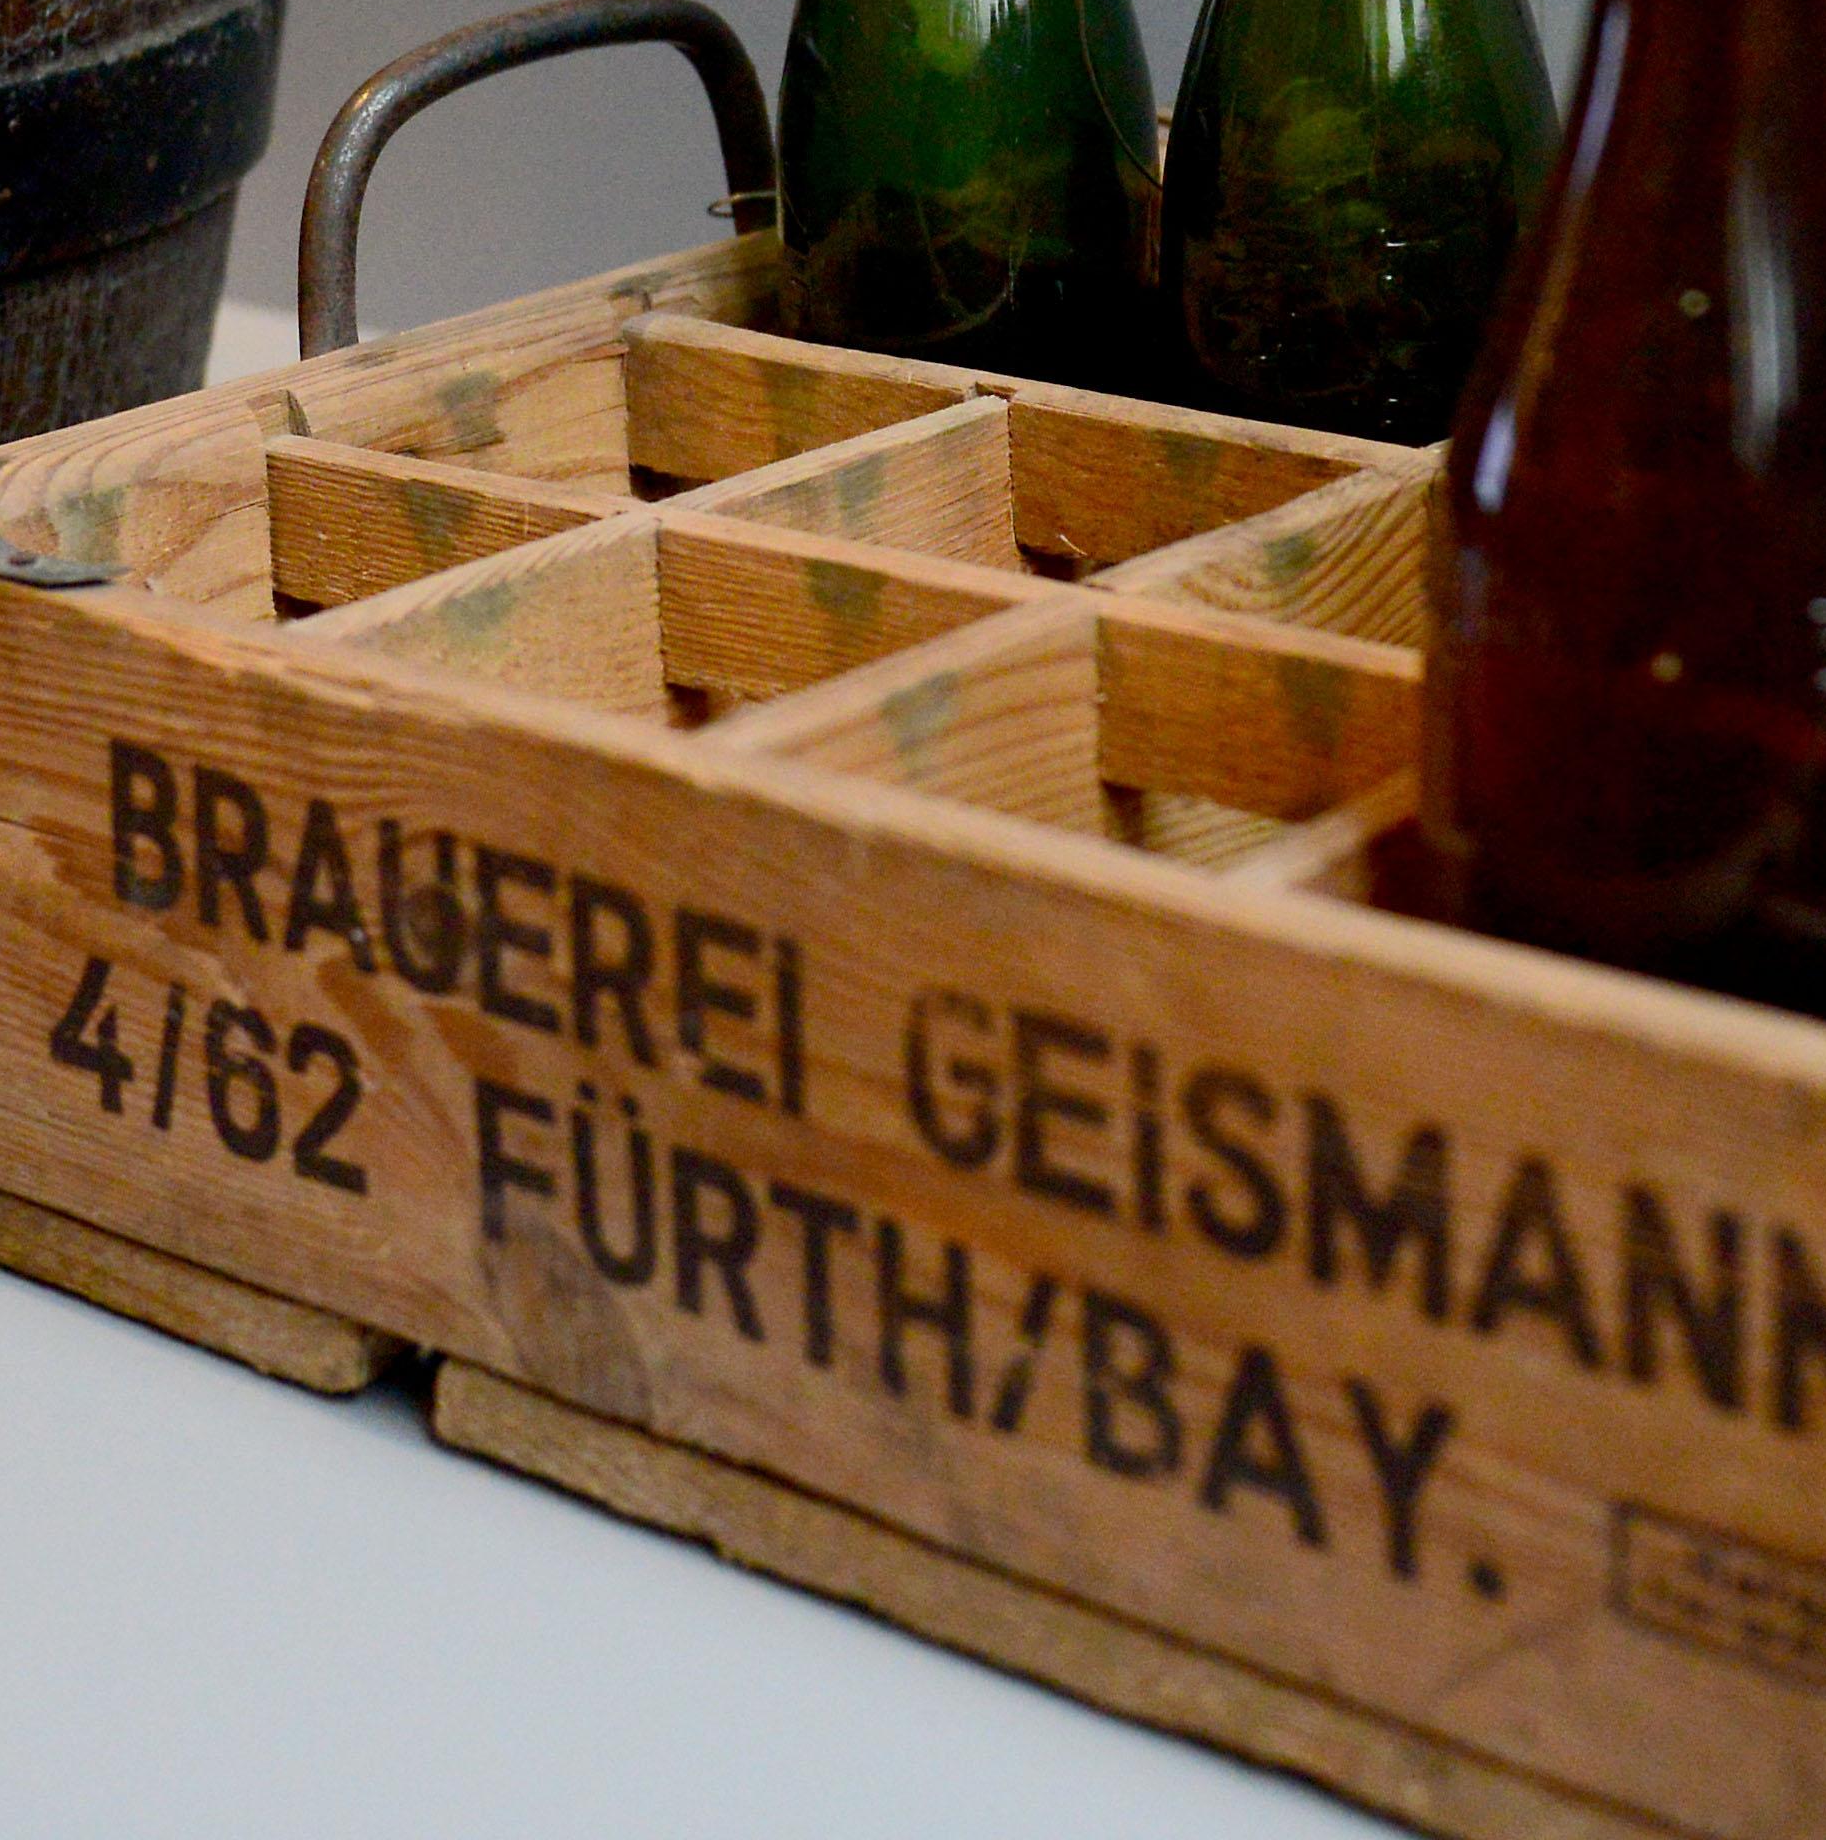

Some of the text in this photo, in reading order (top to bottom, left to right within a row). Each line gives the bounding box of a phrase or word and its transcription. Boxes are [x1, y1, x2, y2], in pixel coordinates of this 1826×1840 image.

[110, 739, 809, 1119] BRAUEREI
[46, 956, 1507, 1603] 4/62 FÜRTH/BAY.
